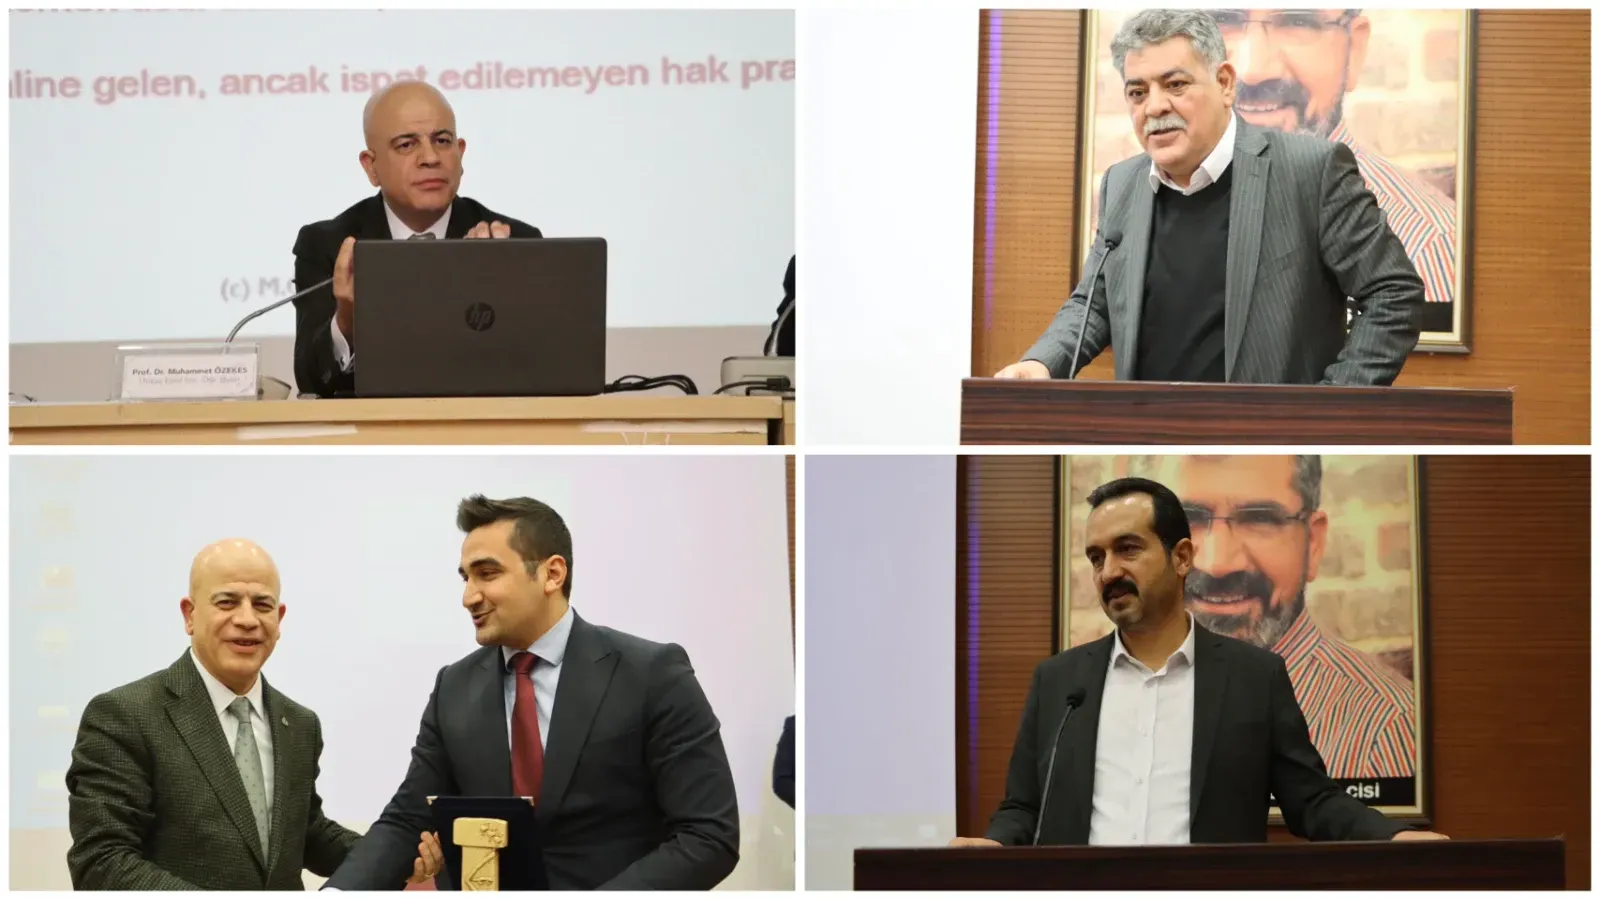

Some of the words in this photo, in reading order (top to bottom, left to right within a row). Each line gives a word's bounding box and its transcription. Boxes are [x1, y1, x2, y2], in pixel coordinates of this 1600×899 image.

[9, 69, 81, 98] line
[93, 69, 207, 105] gelen,
[219, 63, 330, 96] ancak
[438, 61, 649, 94] edilemeyen
[661, 54, 730, 84] hak
[467, 302, 494, 331] hp
[132, 368, 152, 376] Prof.
[168, 366, 212, 375] Muhammet
